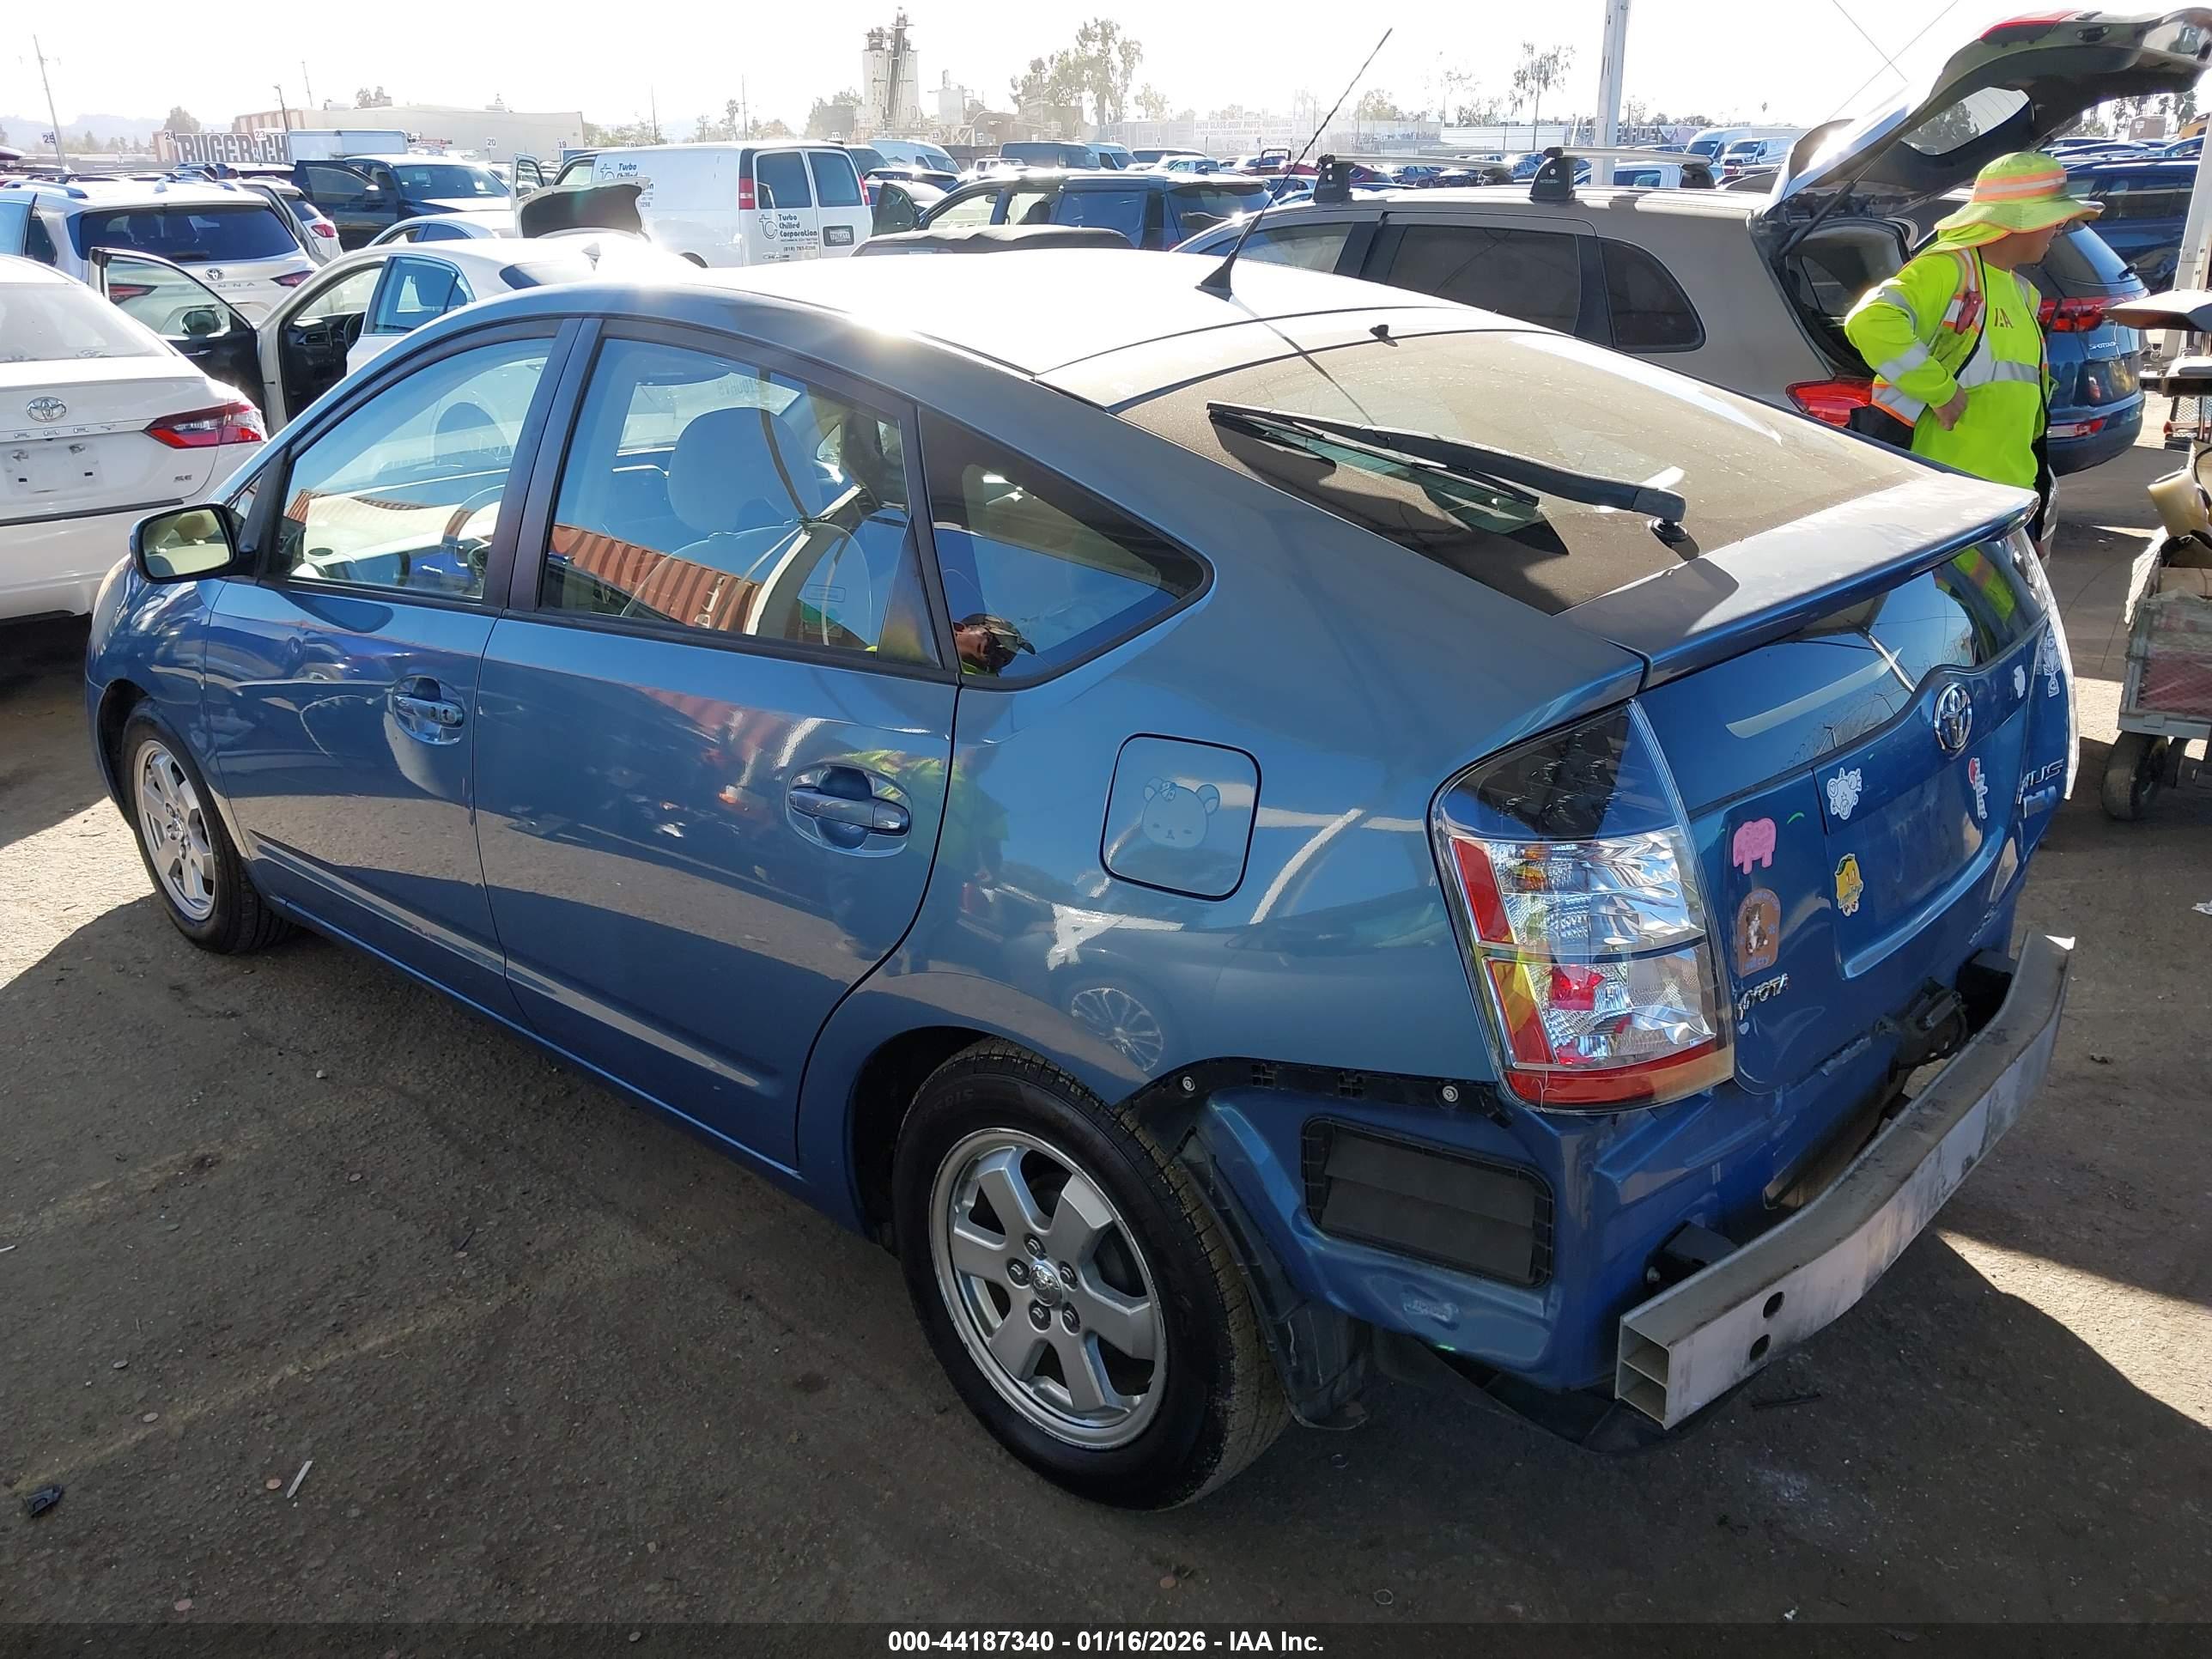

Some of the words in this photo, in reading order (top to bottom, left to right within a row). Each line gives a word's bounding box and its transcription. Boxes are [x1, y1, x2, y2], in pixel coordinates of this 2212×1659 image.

[43, 133, 56, 144] 25
[487, 137, 496, 147] 20
[558, 140, 568, 149] 19
[618, 162, 637, 171] Turbo
[780, 228, 817, 238] Corporation
